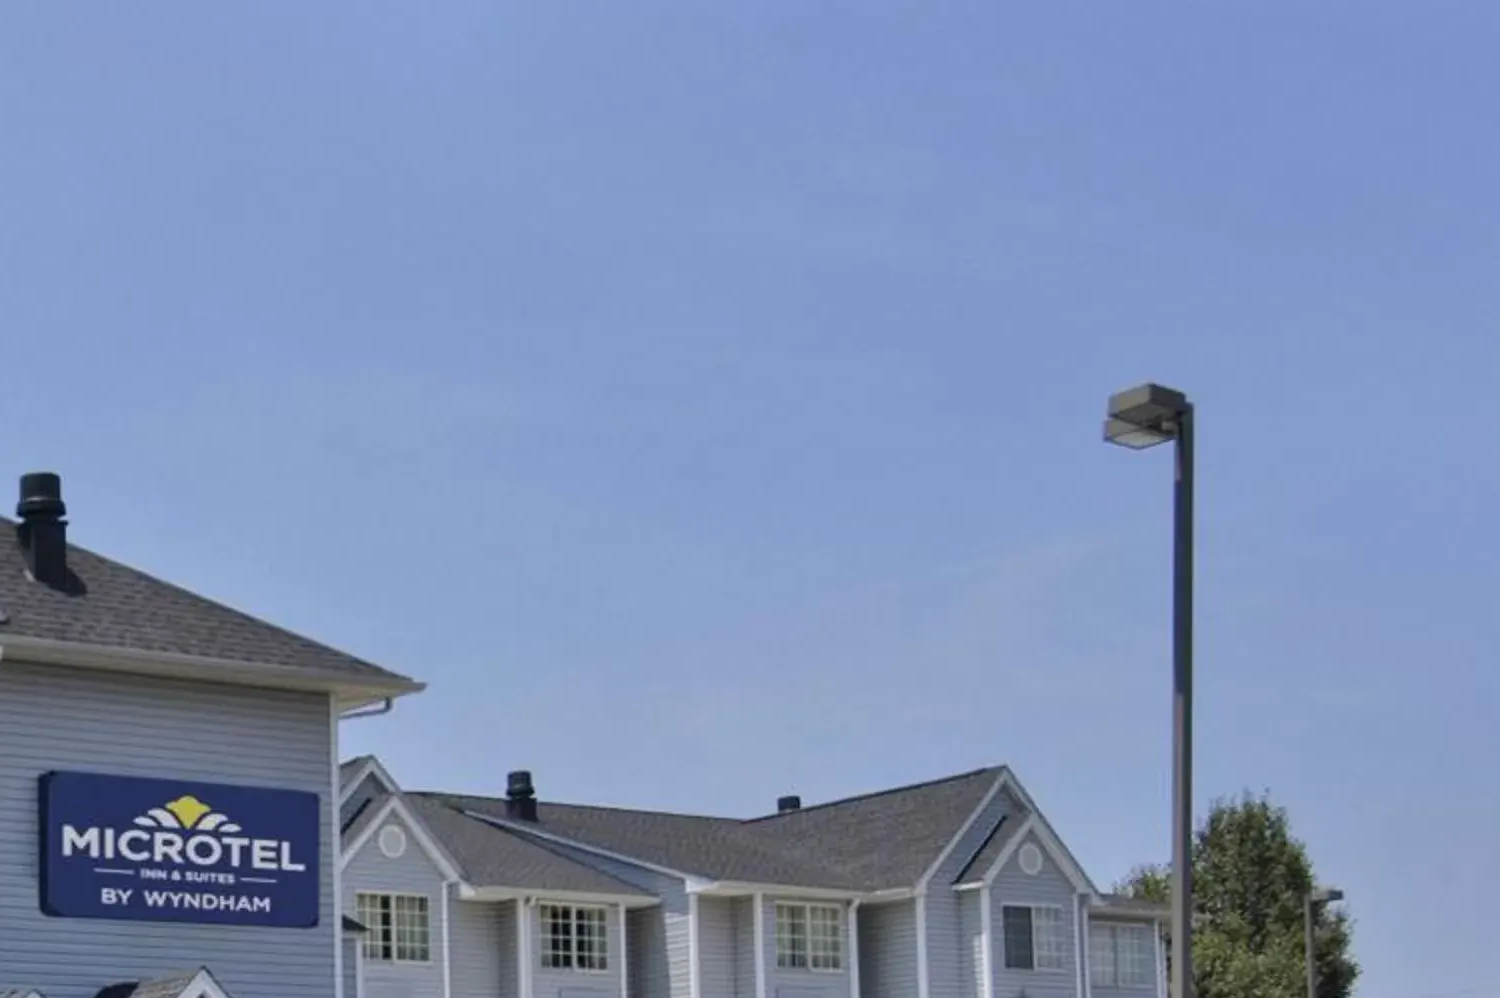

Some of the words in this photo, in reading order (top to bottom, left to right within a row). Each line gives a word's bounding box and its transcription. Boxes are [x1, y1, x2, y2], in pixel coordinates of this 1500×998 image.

[61, 824, 306, 872] MICROTEL
[140, 868, 167, 881] INN
[171, 869, 181, 881] &
[185, 871, 235, 884] SUITES
[101, 887, 133, 905] BY
[143, 889, 271, 913] WYNDHAM
